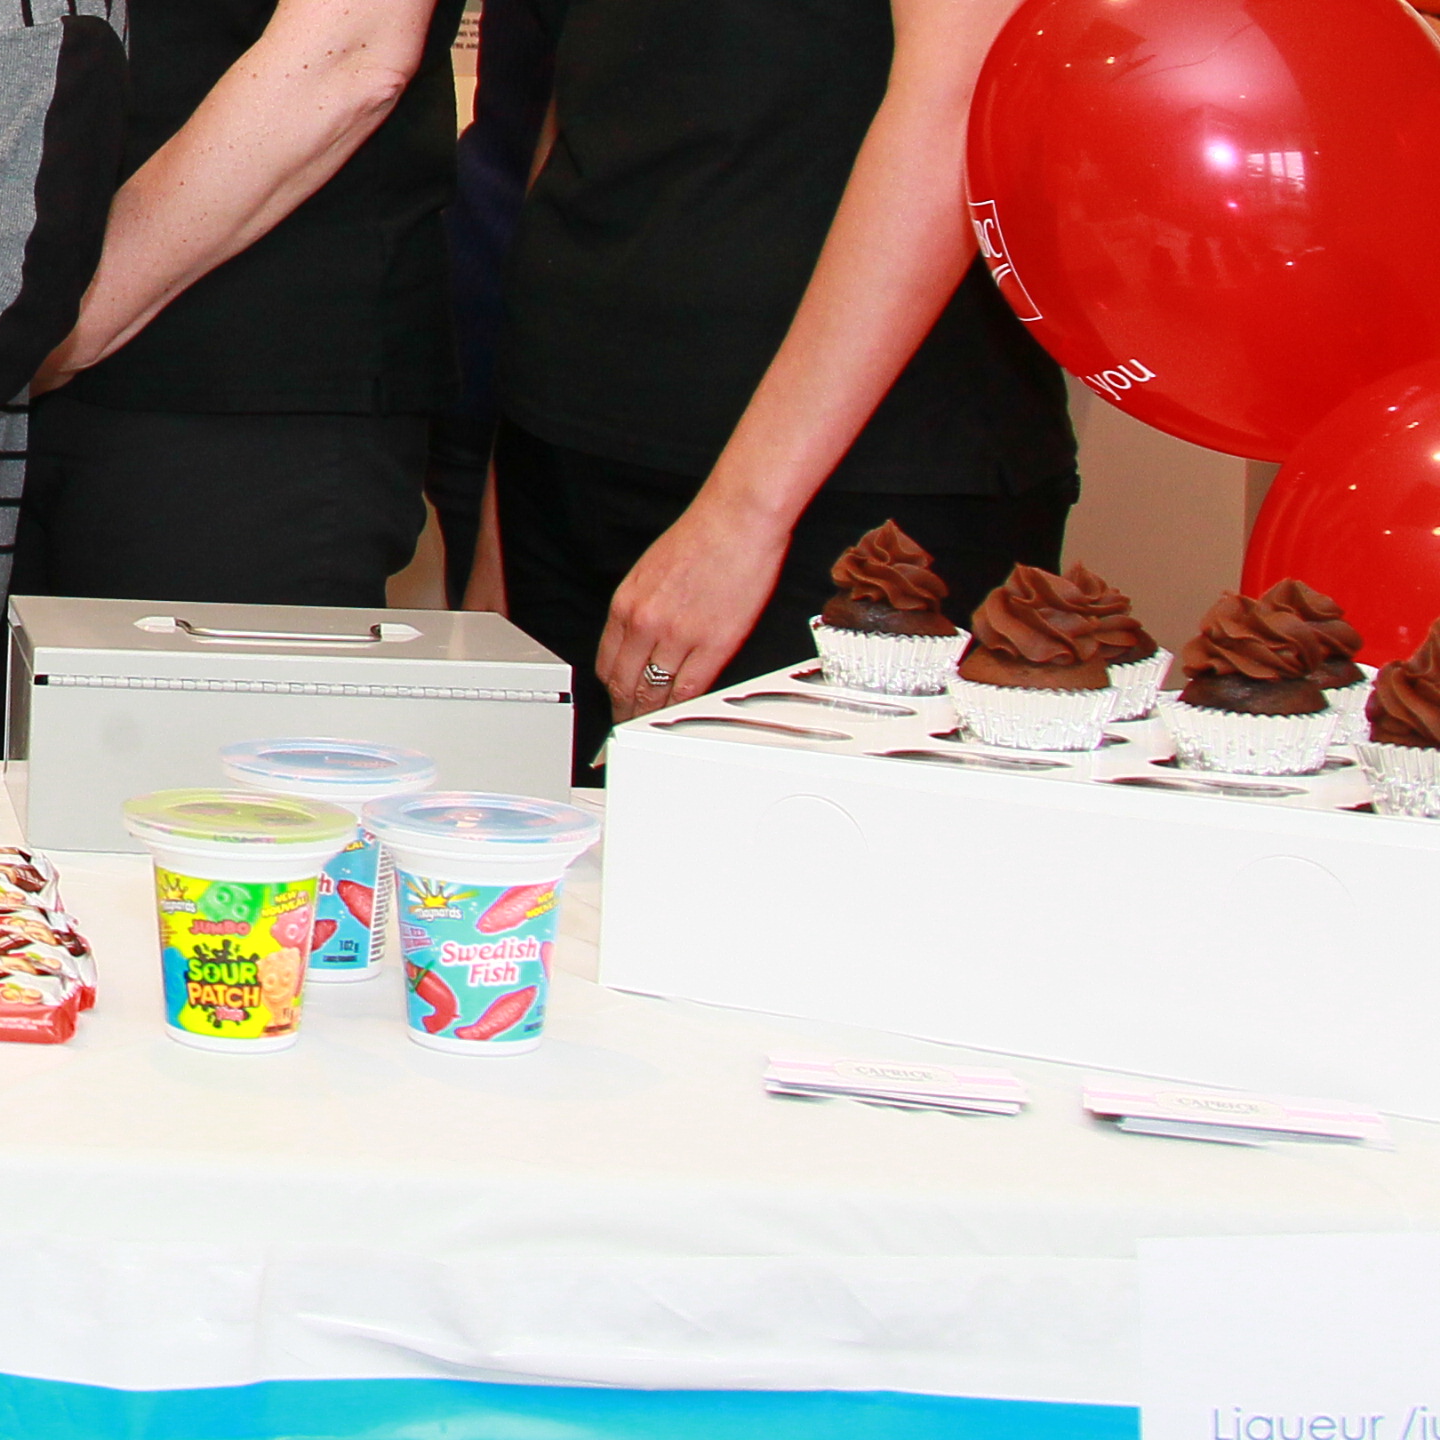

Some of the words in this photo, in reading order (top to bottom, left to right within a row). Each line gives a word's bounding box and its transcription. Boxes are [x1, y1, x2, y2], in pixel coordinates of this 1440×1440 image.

[188, 919, 251, 936] JUMBO
[440, 937, 539, 964] Swedish
[188, 958, 258, 985] SOUR
[470, 962, 517, 984] Fish
[186, 981, 262, 1009] PATCH
[854, 1065, 934, 1081] CAPRICE
[1175, 1096, 1261, 1112] CAPRICE
